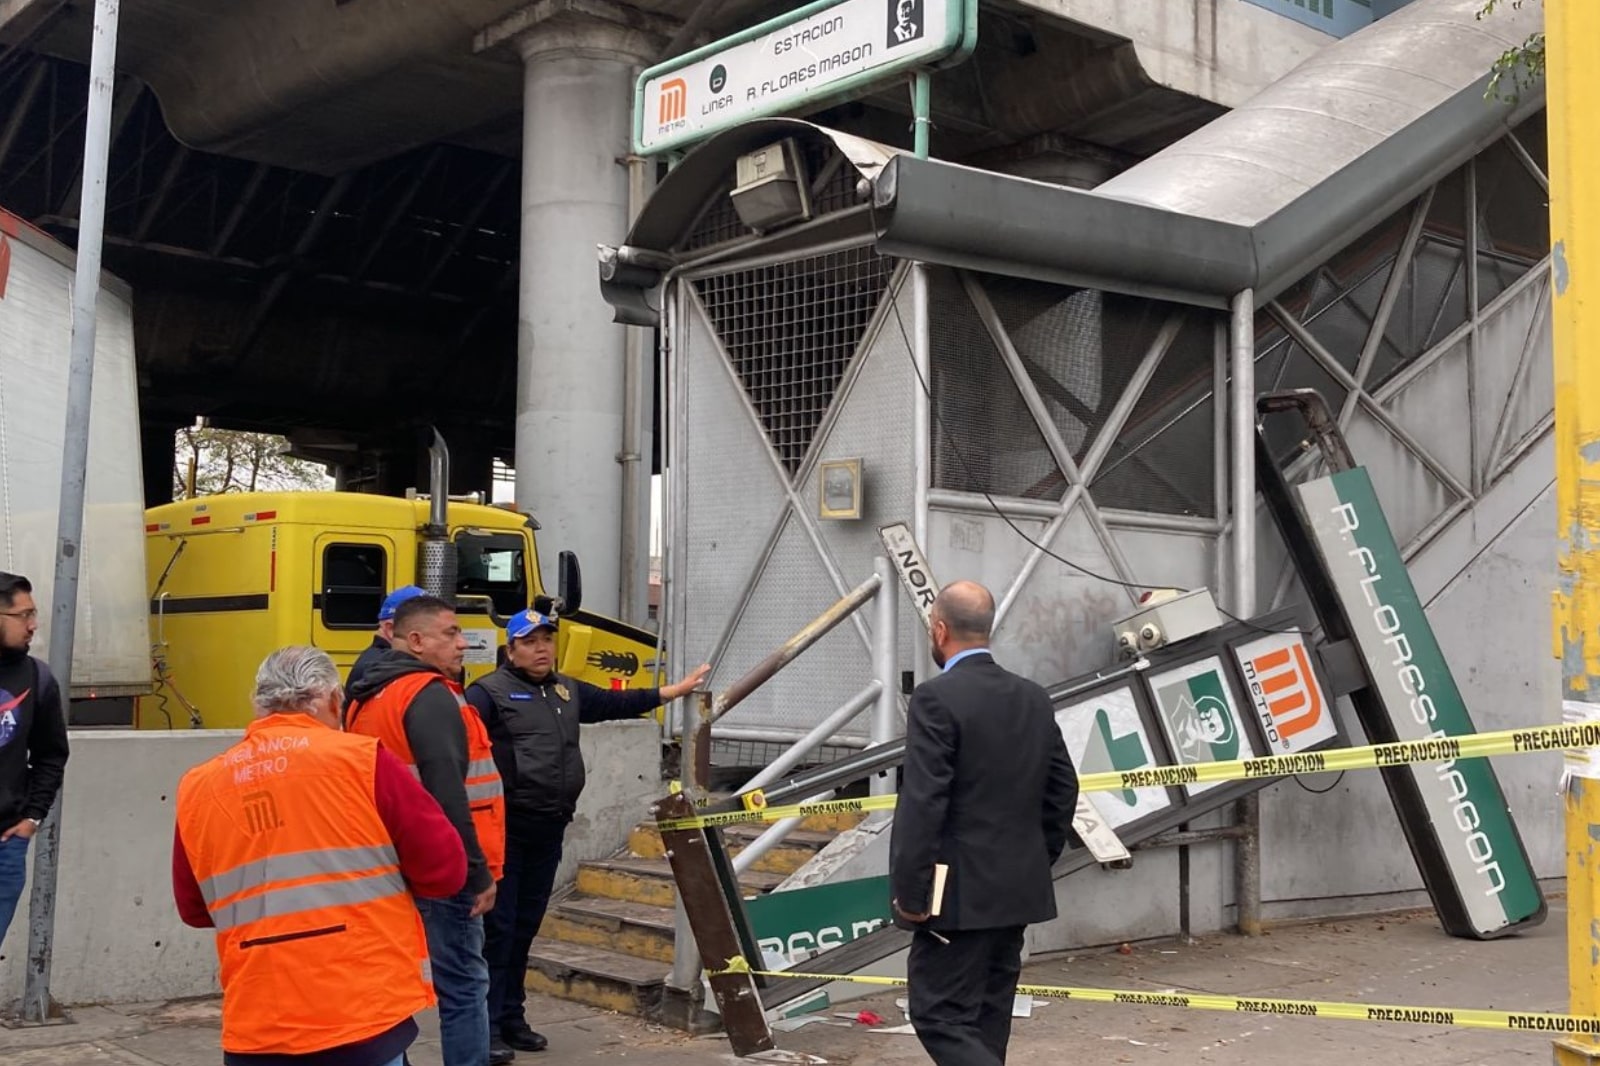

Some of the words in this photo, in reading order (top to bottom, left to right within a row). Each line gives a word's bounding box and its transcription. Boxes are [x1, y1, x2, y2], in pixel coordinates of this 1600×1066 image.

[774, 16, 843, 55] ESTACION
[761, 64, 816, 96] FLORES
[819, 42, 872, 74] MAGON
[701, 94, 734, 115] LINEA
[1331, 502, 1359, 541] R.
[1348, 546, 1437, 725] FLORES
[1243, 660, 1279, 743] METRO
[1121, 767, 1198, 788] PRECAUCION
[1244, 753, 1326, 777] PRECAUCION
[1374, 739, 1461, 765] PRECAUCION
[1236, 1000, 1318, 1016] PRECAUCION
[1367, 1008, 1454, 1025] PRECAUCION
